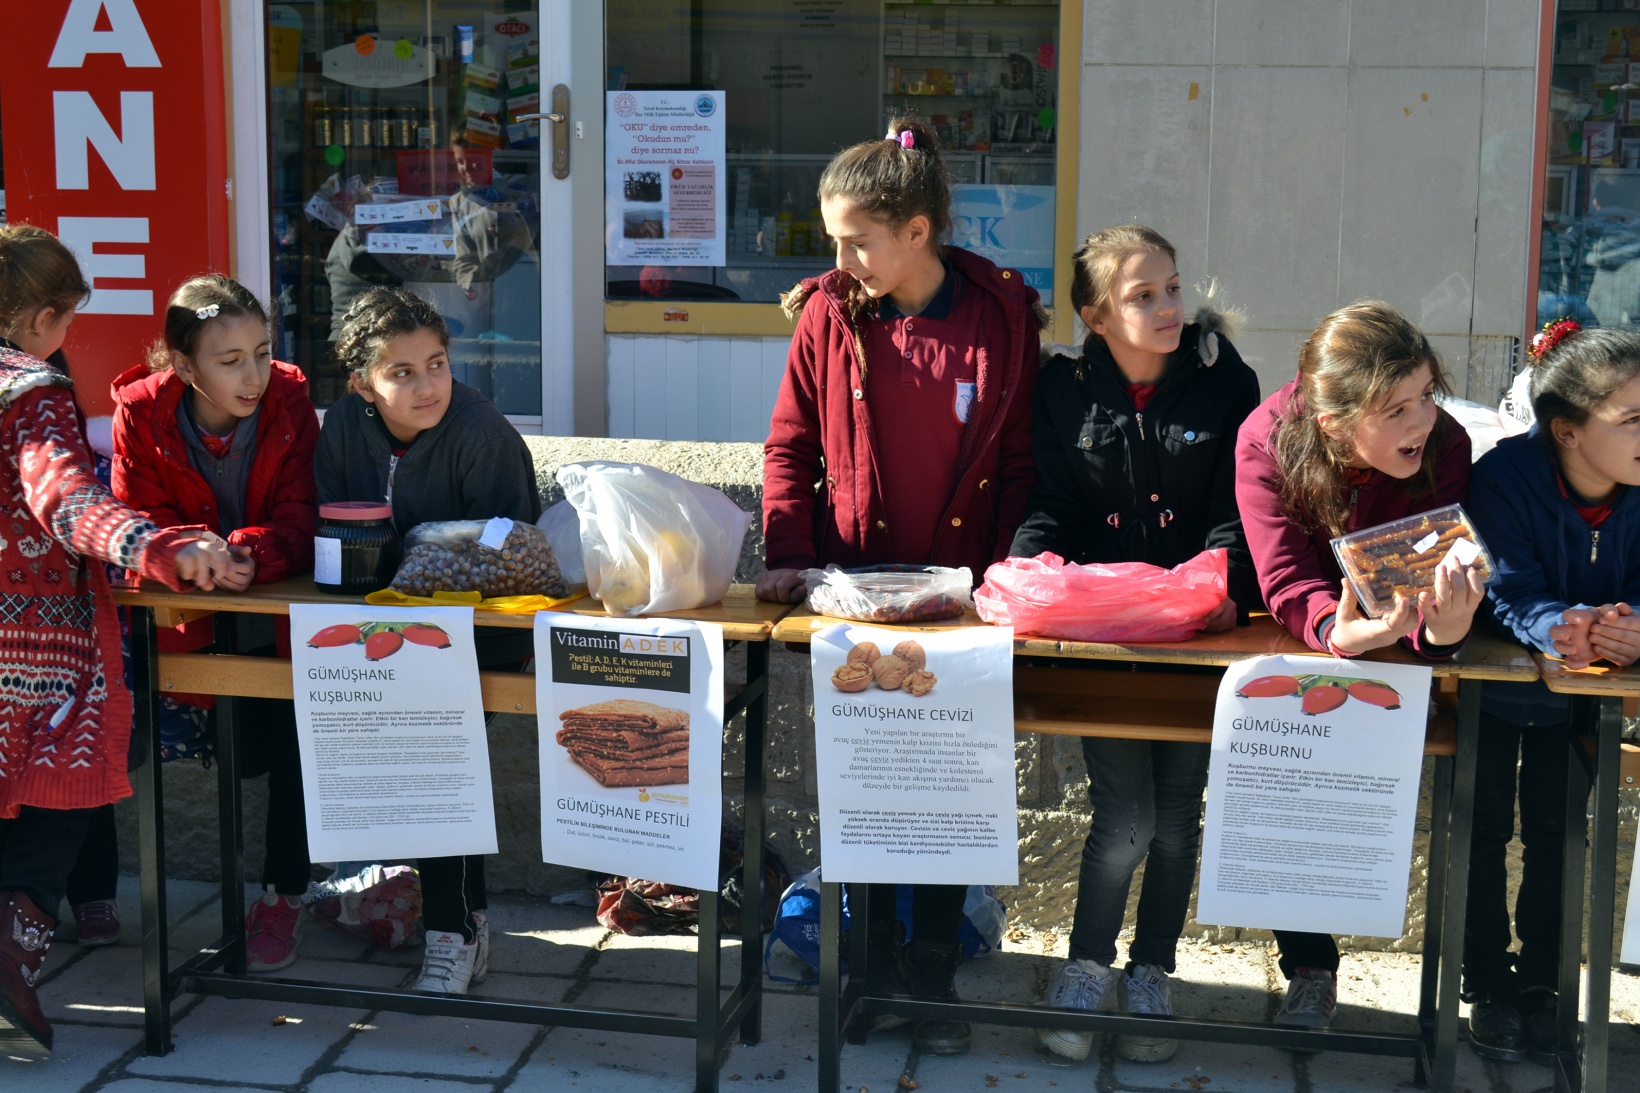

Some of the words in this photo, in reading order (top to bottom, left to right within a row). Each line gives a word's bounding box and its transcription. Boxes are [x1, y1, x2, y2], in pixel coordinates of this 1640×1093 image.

[650, 124, 668, 132] diye
[631, 146, 649, 155] diye
[556, 631, 618, 650] Vitamin
[628, 658, 673, 668] vitaminleri
[308, 666, 396, 683] GÜMÜŞHANE
[590, 664, 613, 673] grubu
[614, 666, 659, 676] vitaminlere
[604, 674, 638, 684] sahiptir.
[309, 690, 382, 704] KUŞBURNU
[832, 703, 925, 721] GÜMÜŞHANE
[930, 708, 973, 721] CEVİZİ
[1232, 716, 1331, 737] GÜMÜŞHANE
[883, 729, 908, 738] yapılan
[922, 731, 953, 740] araştırma
[871, 737, 900, 747] yemenin
[902, 738, 917, 747] kalp
[962, 740, 997, 750] önlediğini
[855, 745, 891, 756] gösteriyor.
[894, 747, 935, 757] Araştırmada
[1230, 742, 1312, 759] KUŞBURNU
[890, 756, 920, 766] yedikten
[849, 764, 892, 772] damarlarının
[894, 765, 937, 775] esnekliğinde
[840, 772, 885, 782] seviyelerinde
[887, 773, 896, 783] iyi
[912, 774, 936, 784] akışına
[939, 775, 969, 785] yardımcı
[863, 782, 891, 791] düzeyde
[905, 783, 931, 793] gelişme
[933, 784, 971, 794] kaydedildi.
[557, 797, 641, 820] GÜMÜŞHANE
[645, 810, 690, 827] PESTİLİ
[581, 821, 613, 831] BİLEŞİMİNDE
[641, 831, 671, 839] MADDELER
[916, 848, 952, 856] yönündeydi.
